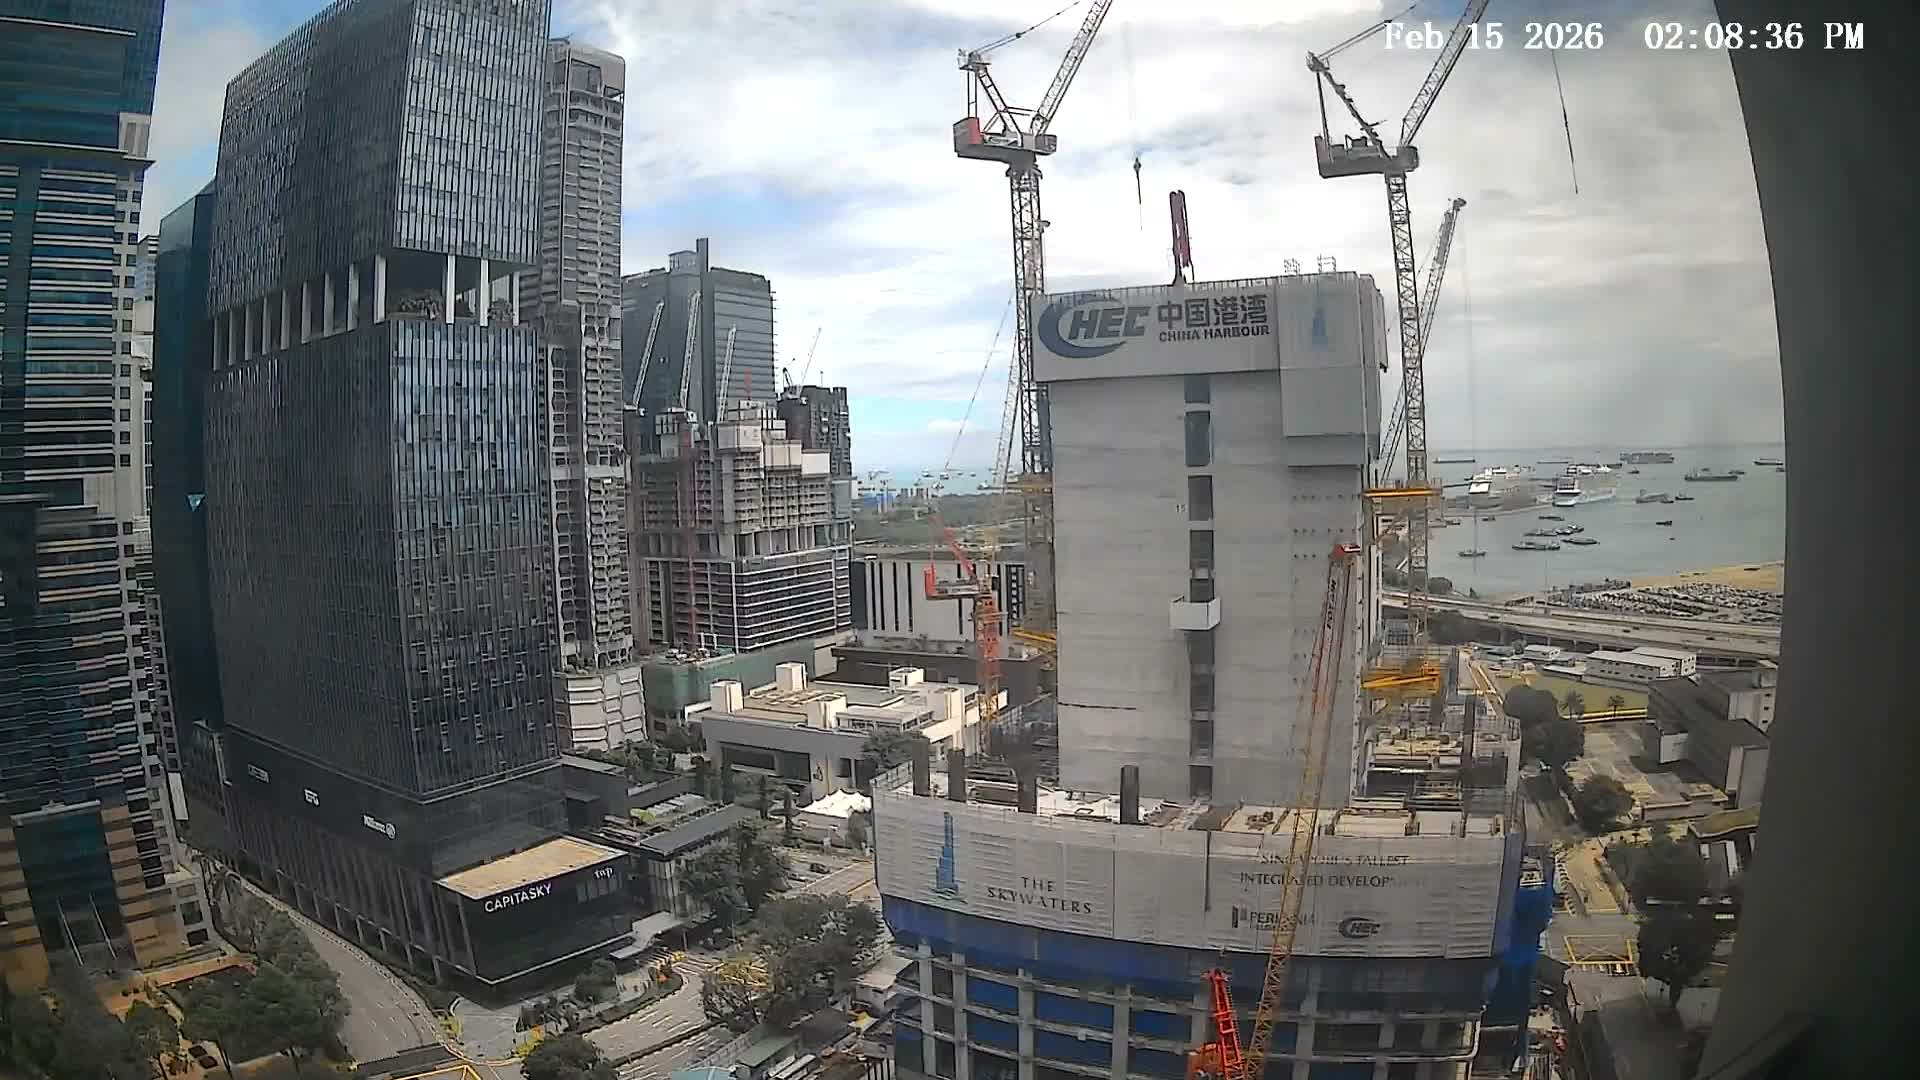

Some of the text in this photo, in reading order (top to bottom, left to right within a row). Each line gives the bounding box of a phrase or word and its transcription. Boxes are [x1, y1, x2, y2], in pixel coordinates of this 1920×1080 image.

[1157, 294, 1268, 328] 中国港湾
[1159, 324, 1270, 343] CHINA HARBOUR
[484, 883, 552, 912] CAPITASKY
[1022, 876, 1055, 892] THE
[987, 886, 1092, 914] SKYWATERS
